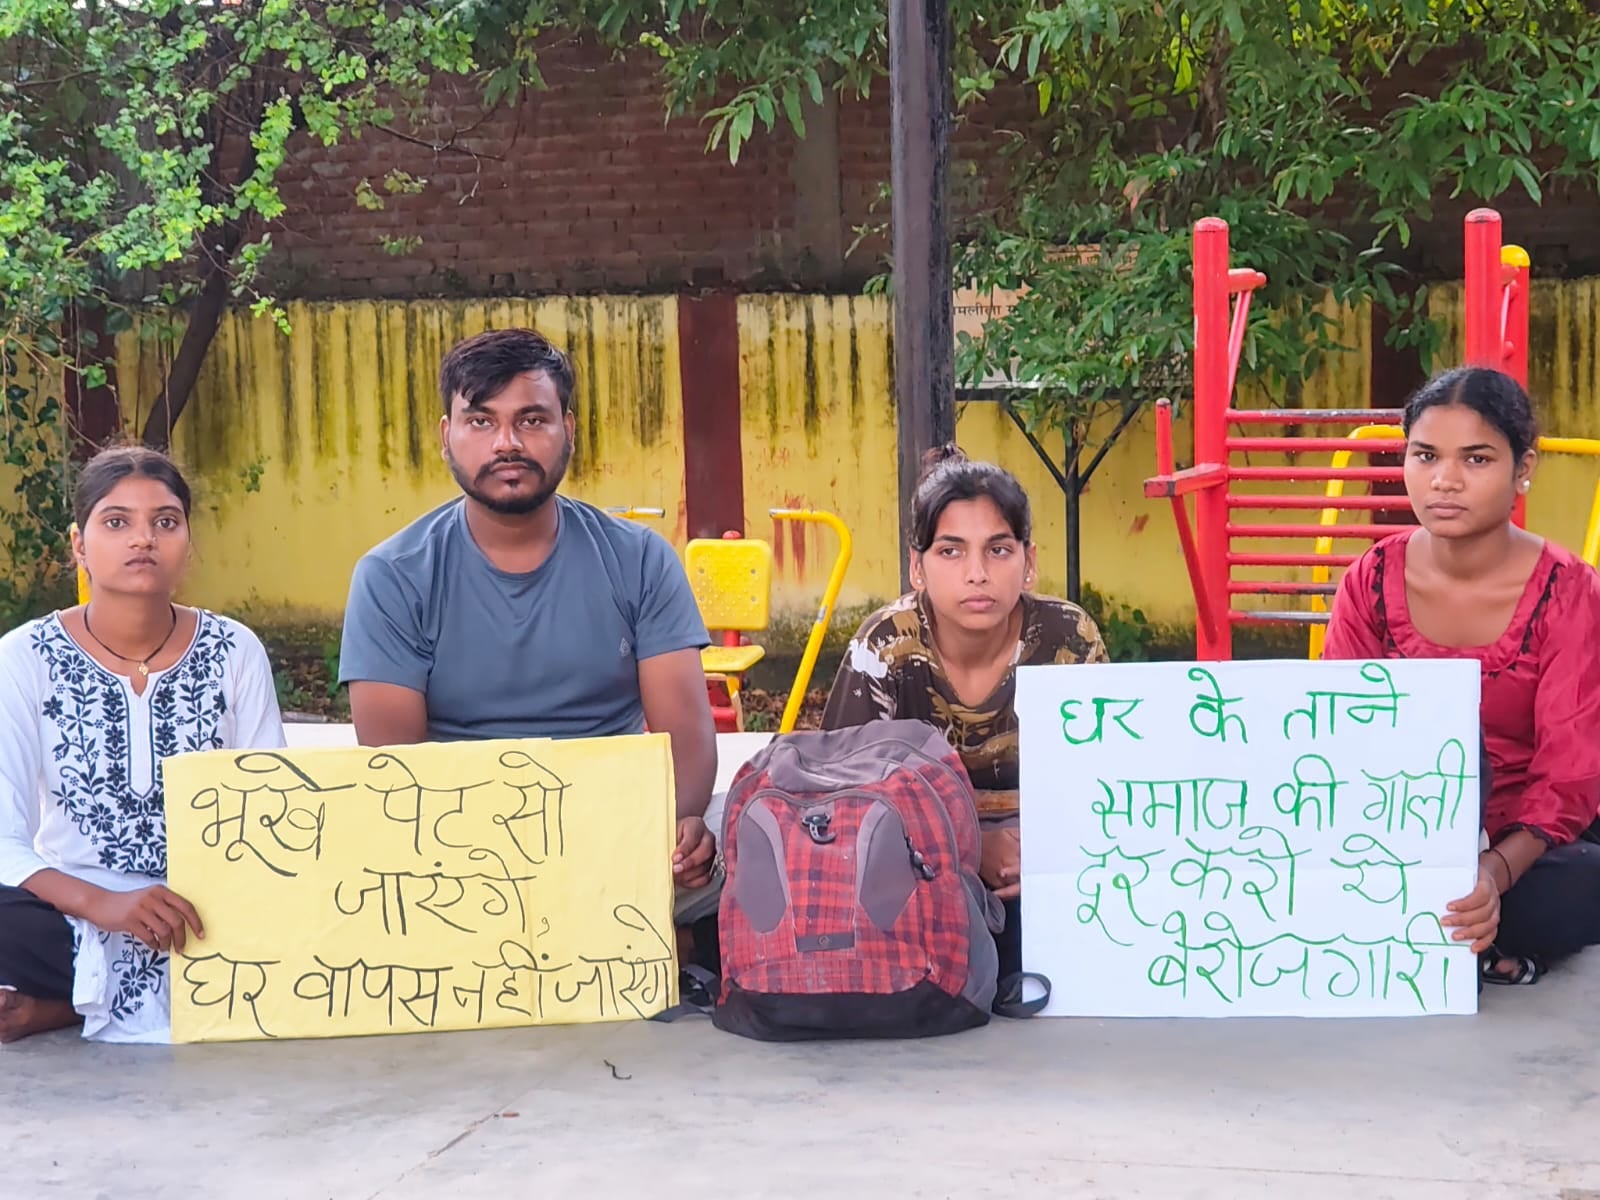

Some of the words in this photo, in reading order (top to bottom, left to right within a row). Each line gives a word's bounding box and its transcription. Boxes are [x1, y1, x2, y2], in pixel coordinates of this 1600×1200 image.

[1060, 696, 1145, 745] घर
[1186, 667, 1249, 744] के
[1282, 662, 1411, 740] ताने
[191, 751, 357, 877] भूखे
[365, 753, 495, 855] पेट
[492, 750, 573, 864] सो
[1091, 777, 1249, 839] समाज
[1272, 753, 1349, 832] की
[1361, 738, 1478, 839] गाली
[1076, 843, 1167, 947] दूर
[1170, 825, 1313, 923] करो
[1330, 833, 1423, 915] ये
[180, 952, 281, 1038] घर
[294, 953, 454, 1027] वापस
[452, 939, 573, 1024] नहीं
[1147, 910, 1472, 1012] बेरोजगारी
